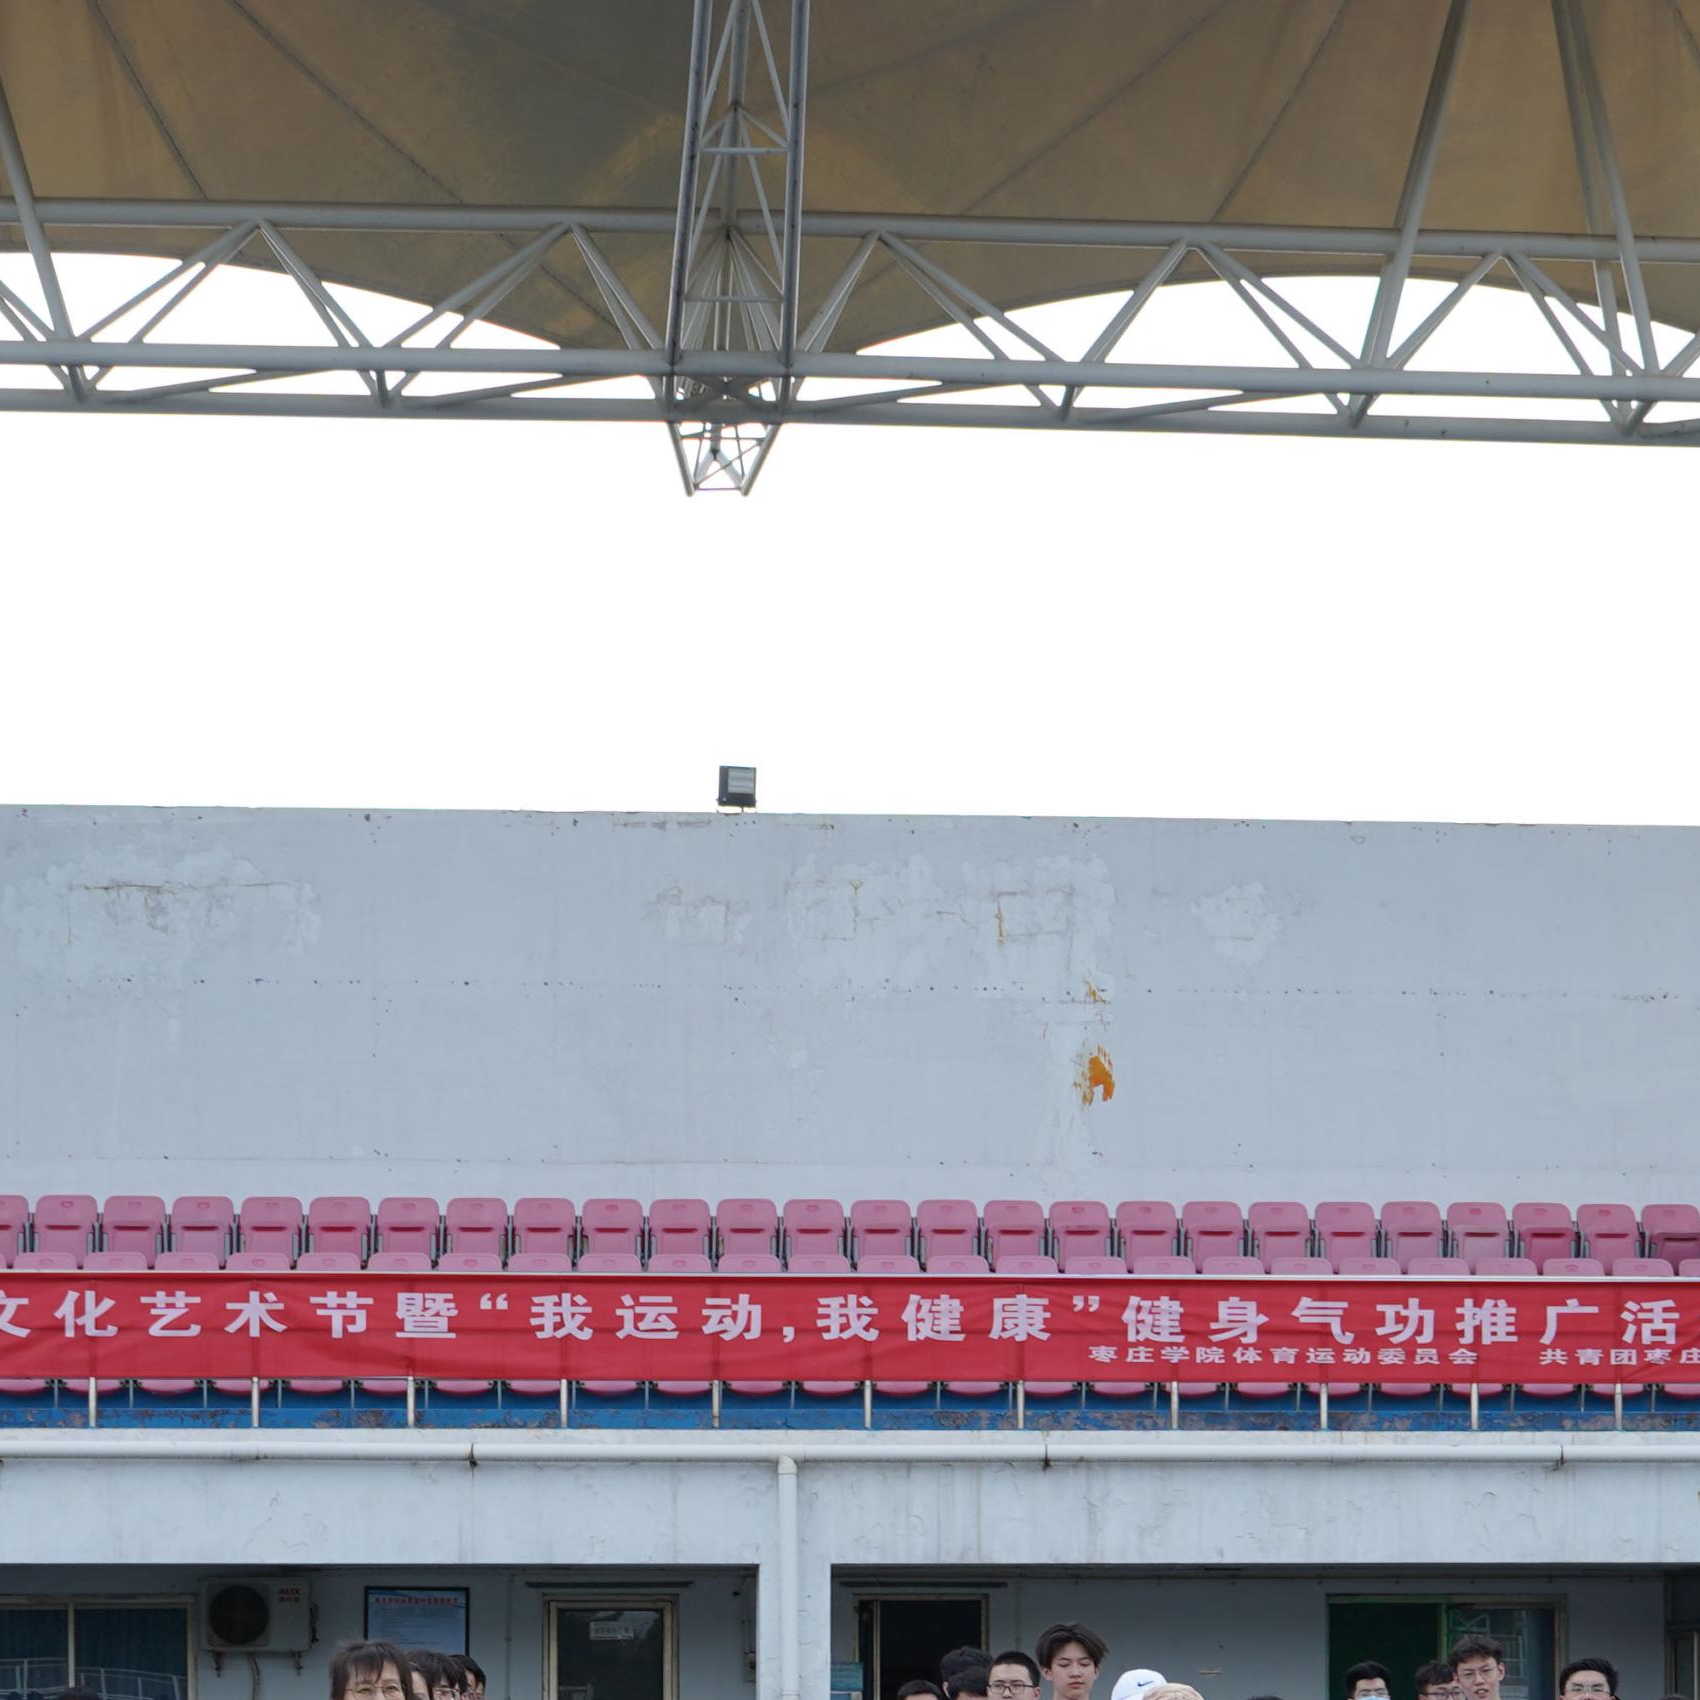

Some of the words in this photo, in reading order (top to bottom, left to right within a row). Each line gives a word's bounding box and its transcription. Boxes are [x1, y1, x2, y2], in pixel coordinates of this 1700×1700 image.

[1088, 1345, 1479, 1365] 枣庄学院体育运动委员会
